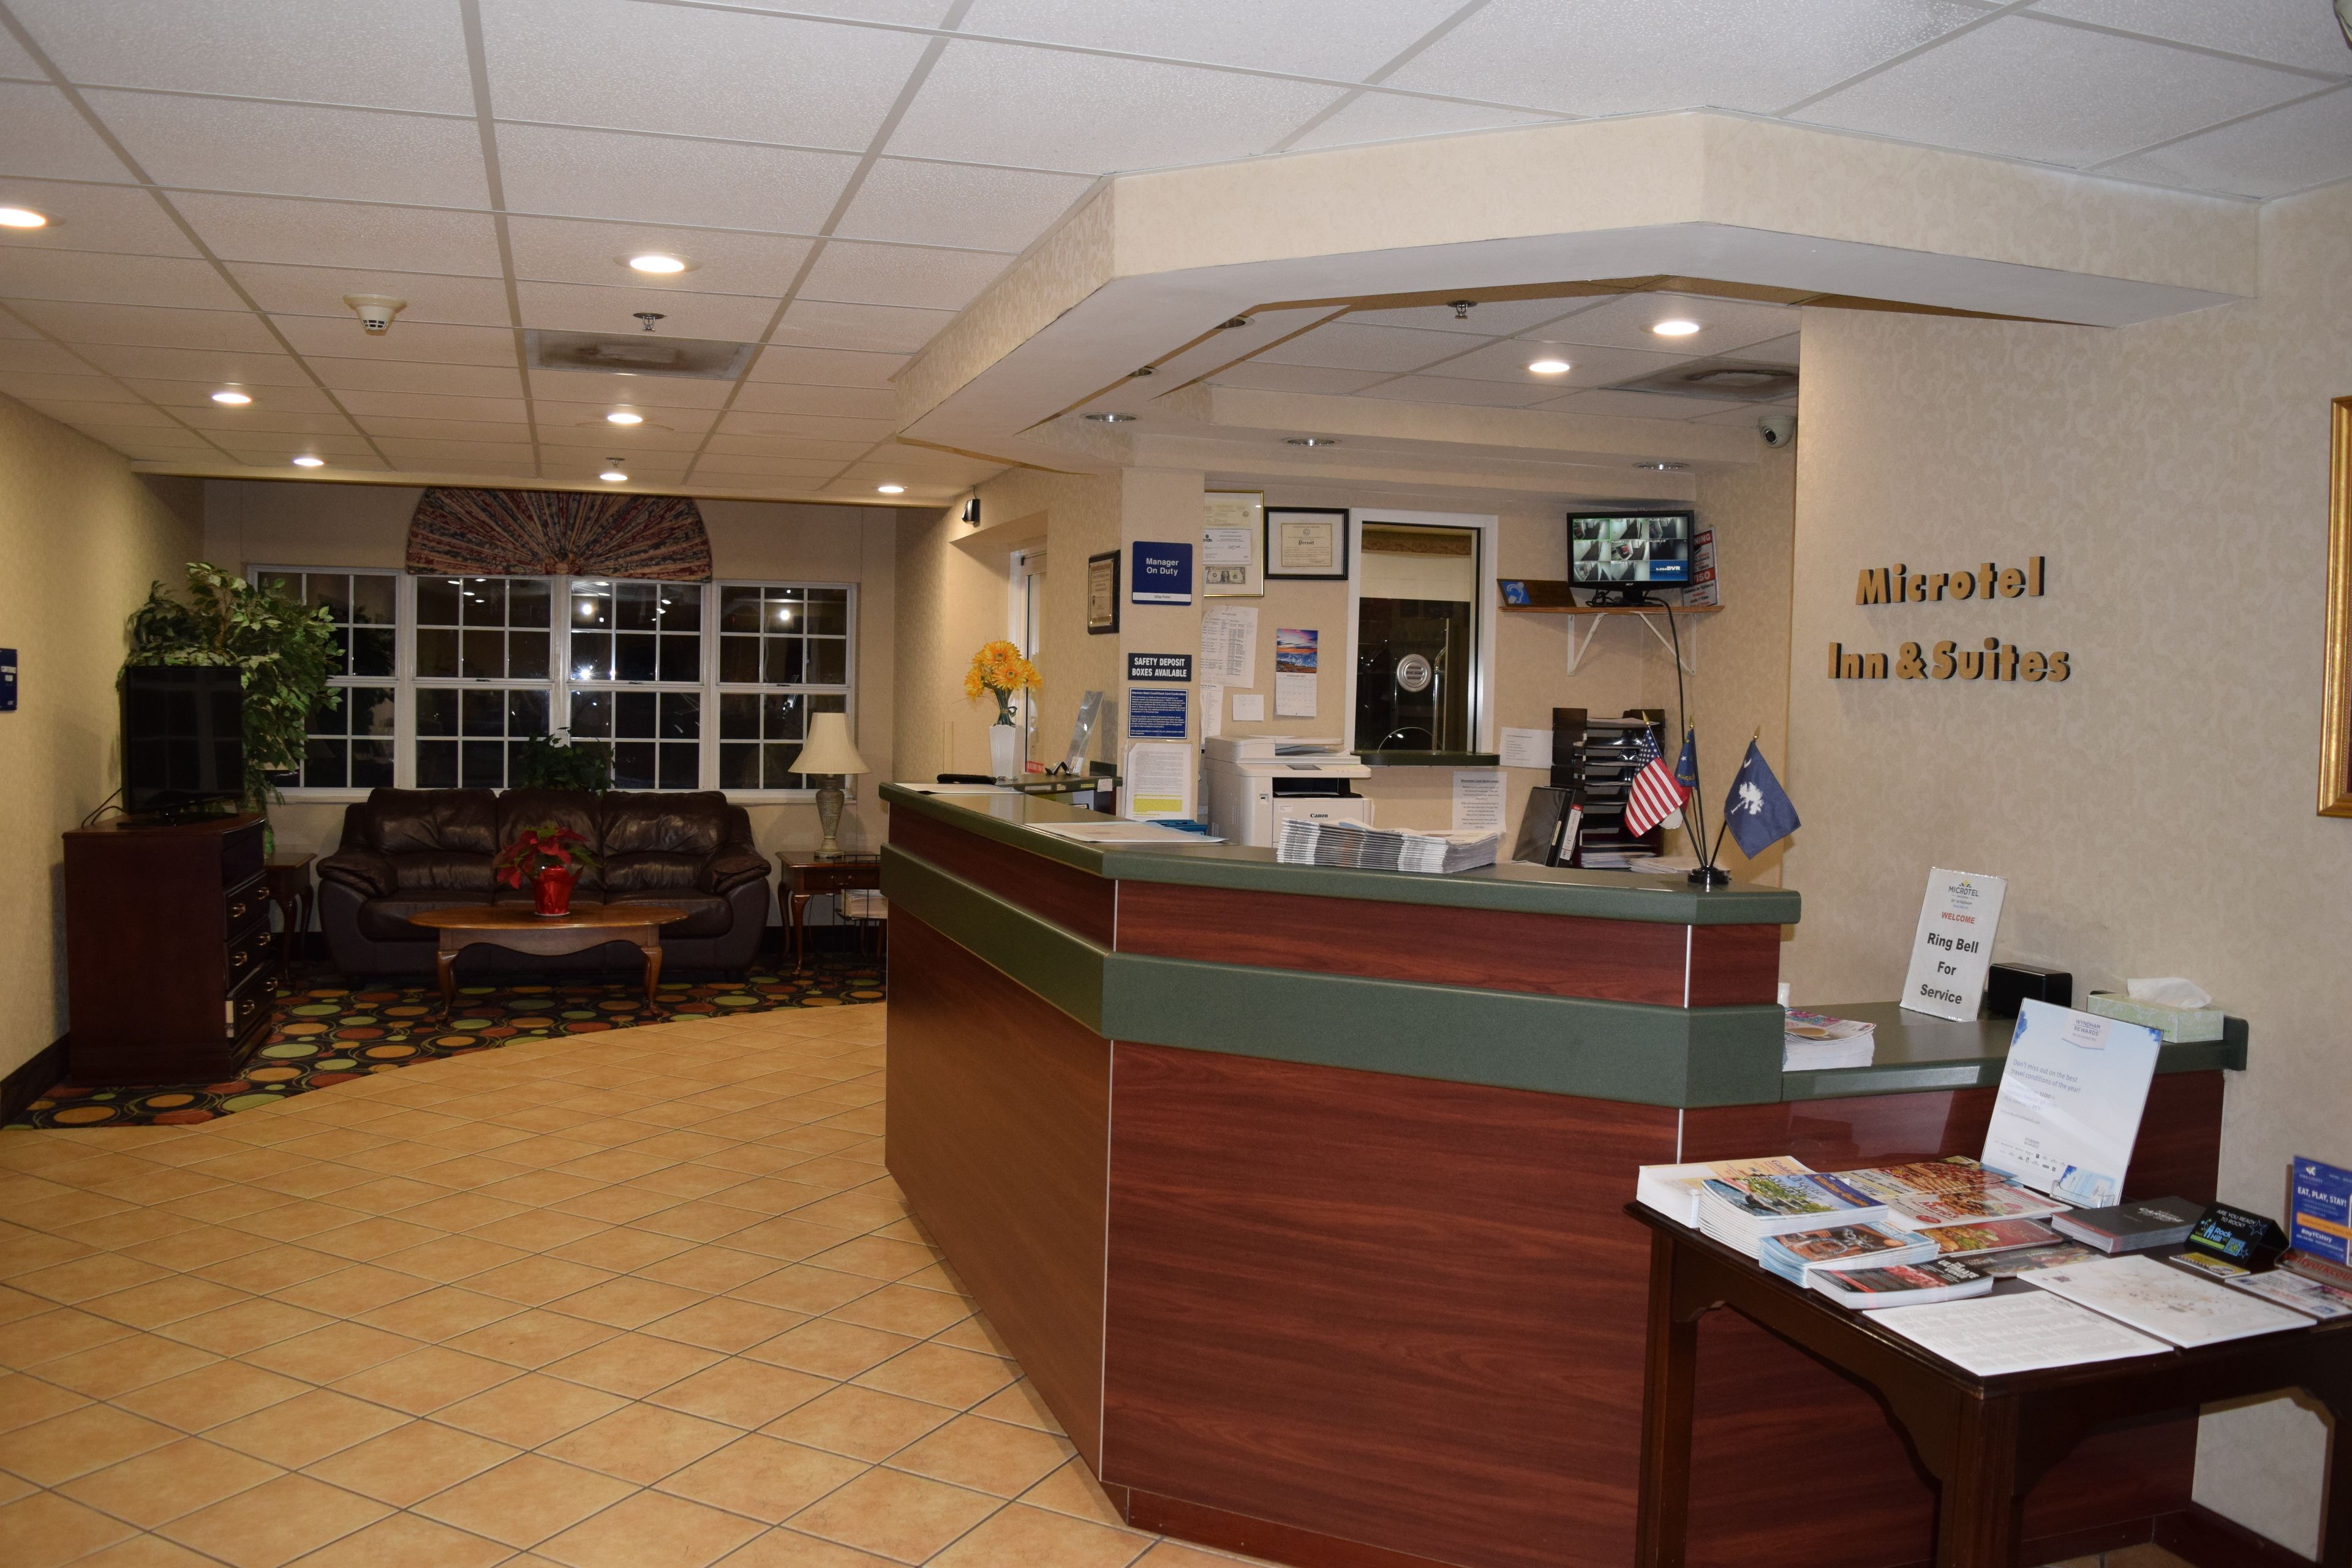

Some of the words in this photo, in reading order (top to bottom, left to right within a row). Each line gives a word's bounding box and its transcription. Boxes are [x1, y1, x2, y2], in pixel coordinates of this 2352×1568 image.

[1694, 533, 1711, 545] NING
[1146, 558, 1179, 567] Manager
[1159, 567, 1178, 576] Duty
[1855, 556, 2045, 605] Microtel
[1134, 657, 1158, 666] SAFETY
[1159, 658, 1185, 667] DEPOSIT
[1828, 643, 1888, 679] Inn
[1132, 668, 1153, 677] BOXES
[1155, 669, 1187, 677] AVAILABLE
[1948, 886, 1979, 897] MICROTEL
[1941, 911, 1975, 924] WELCOME
[1927, 932, 1953, 951] Ring
[1956, 938, 1979, 953] Bell
[1937, 961, 1956, 975] For
[1920, 984, 1962, 1004] Service
[2076, 1019, 2101, 1030] WYNDHAM
[2073, 1026, 2099, 1036] REWARDS
[2013, 1059, 2027, 1069] Don't
[2027, 1062, 2039, 1072] miss
[2066, 1073, 2078, 1082] best
[2011, 1068, 2024, 1077] travel
[2025, 1072, 2051, 1085] conditions
[2067, 1084, 2081, 1093] year!
[2297, 1186, 2310, 1197] EAT,
[2312, 1190, 2329, 1203] PLAY,
[2329, 1196, 2346, 1207] STAY!
[2228, 1219, 2245, 1228] ROCK?
[2239, 1215, 2256, 1226] READY
[2211, 1233, 2222, 1243] Hill
[2214, 1226, 2233, 1238] Rock
[2301, 1228, 2332, 1243] #myYCstory
[1937, 1259, 1980, 1279] ULTIMATE
